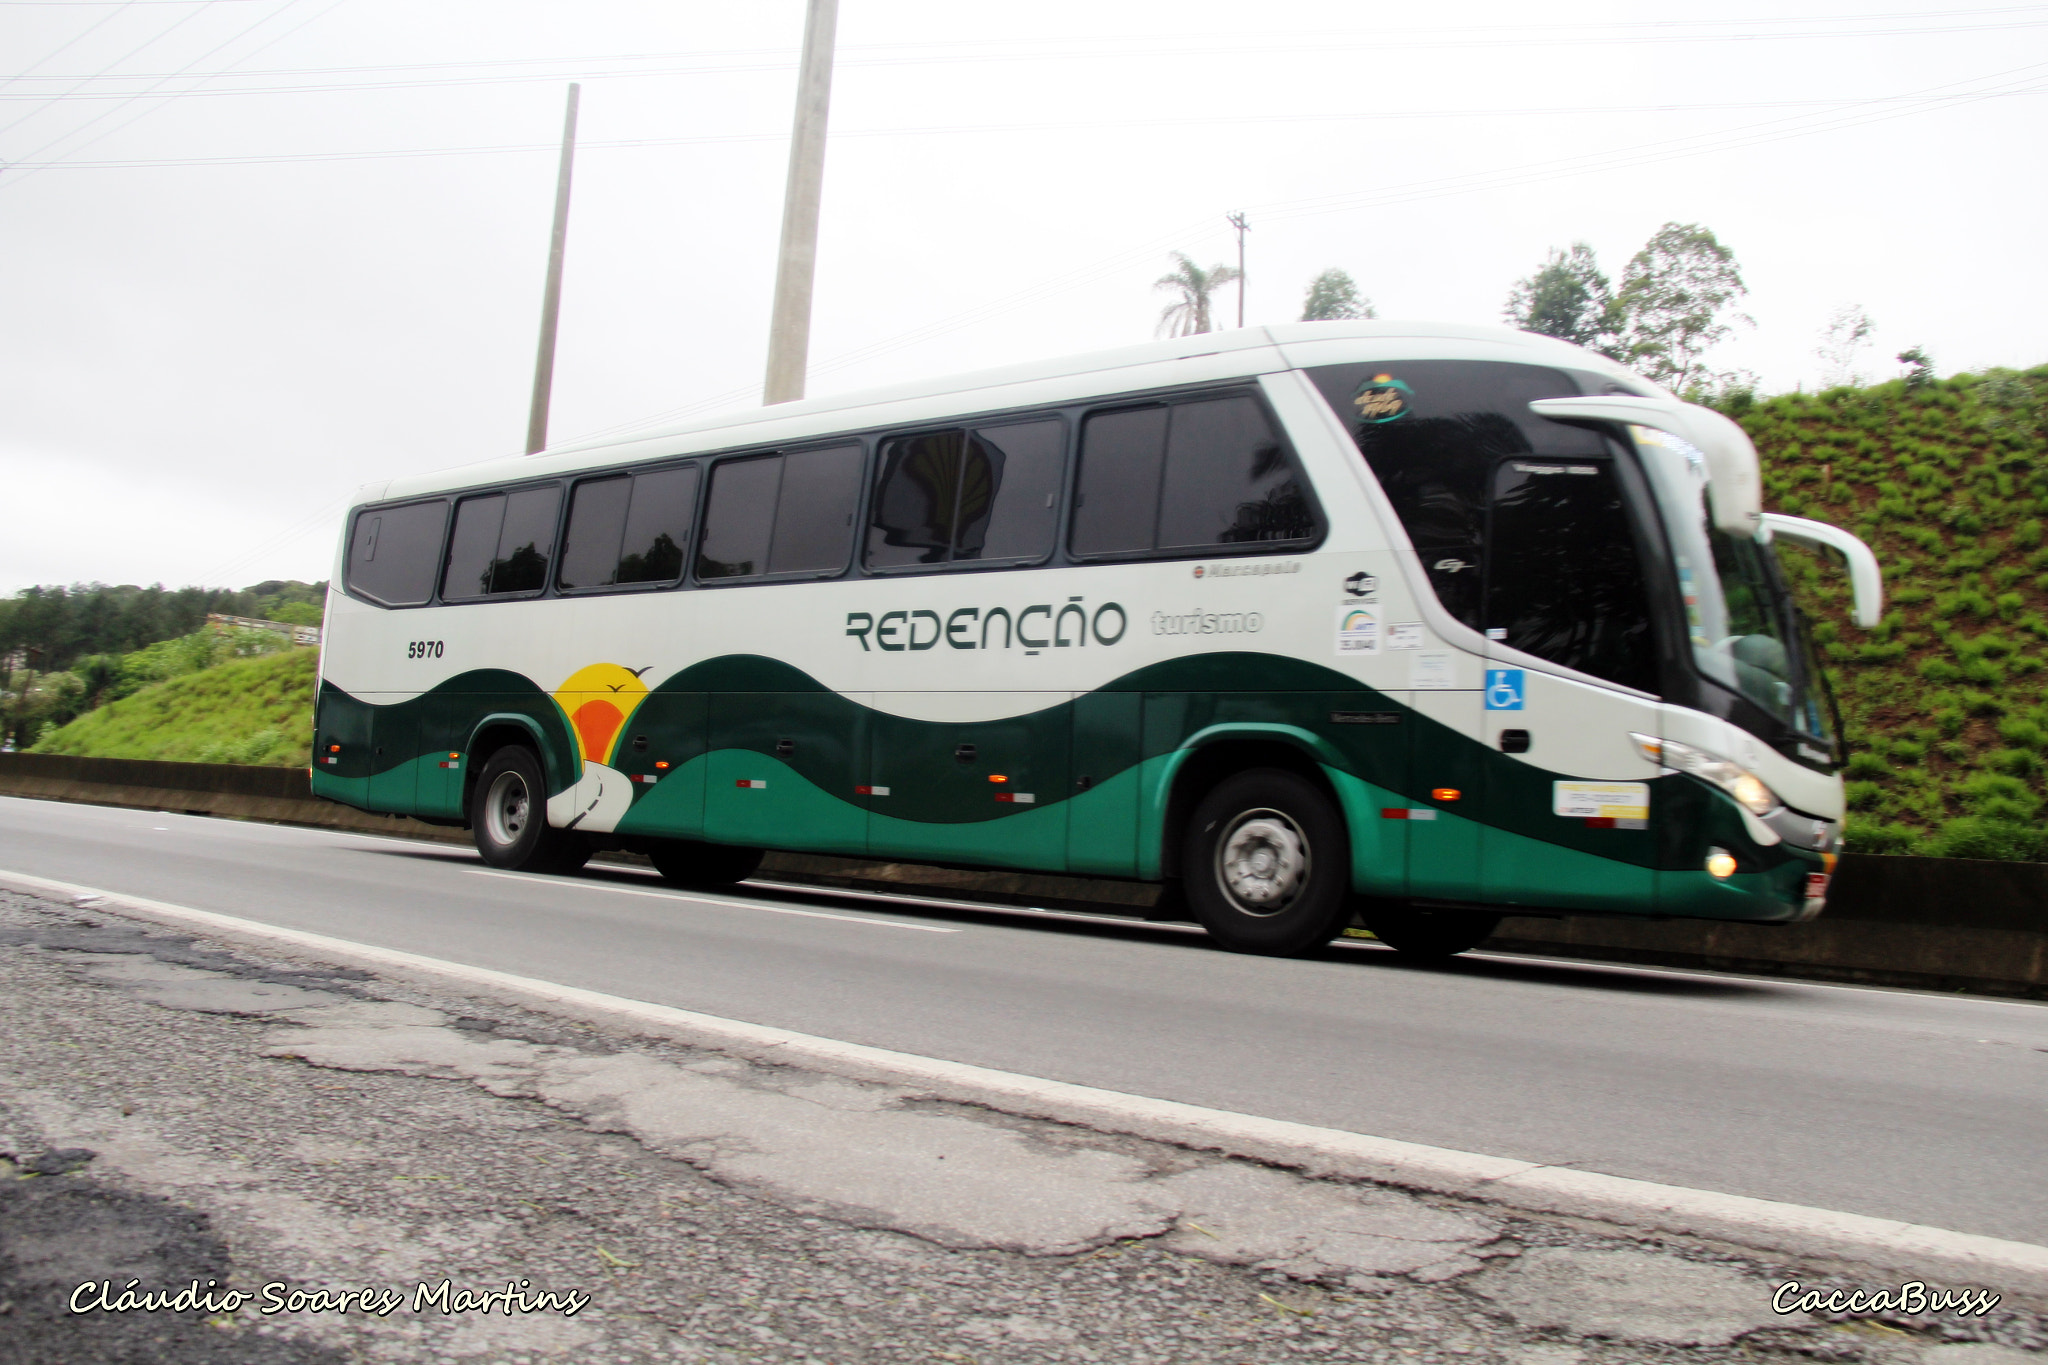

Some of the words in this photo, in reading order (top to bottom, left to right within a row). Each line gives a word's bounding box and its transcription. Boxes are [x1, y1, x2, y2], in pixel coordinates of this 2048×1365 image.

[1207, 561, 1302, 577] Marcopolo
[846, 595, 1127, 656] REDENÇÃO
[1151, 607, 1264, 635] turismo
[408, 640, 444, 659] 5970
